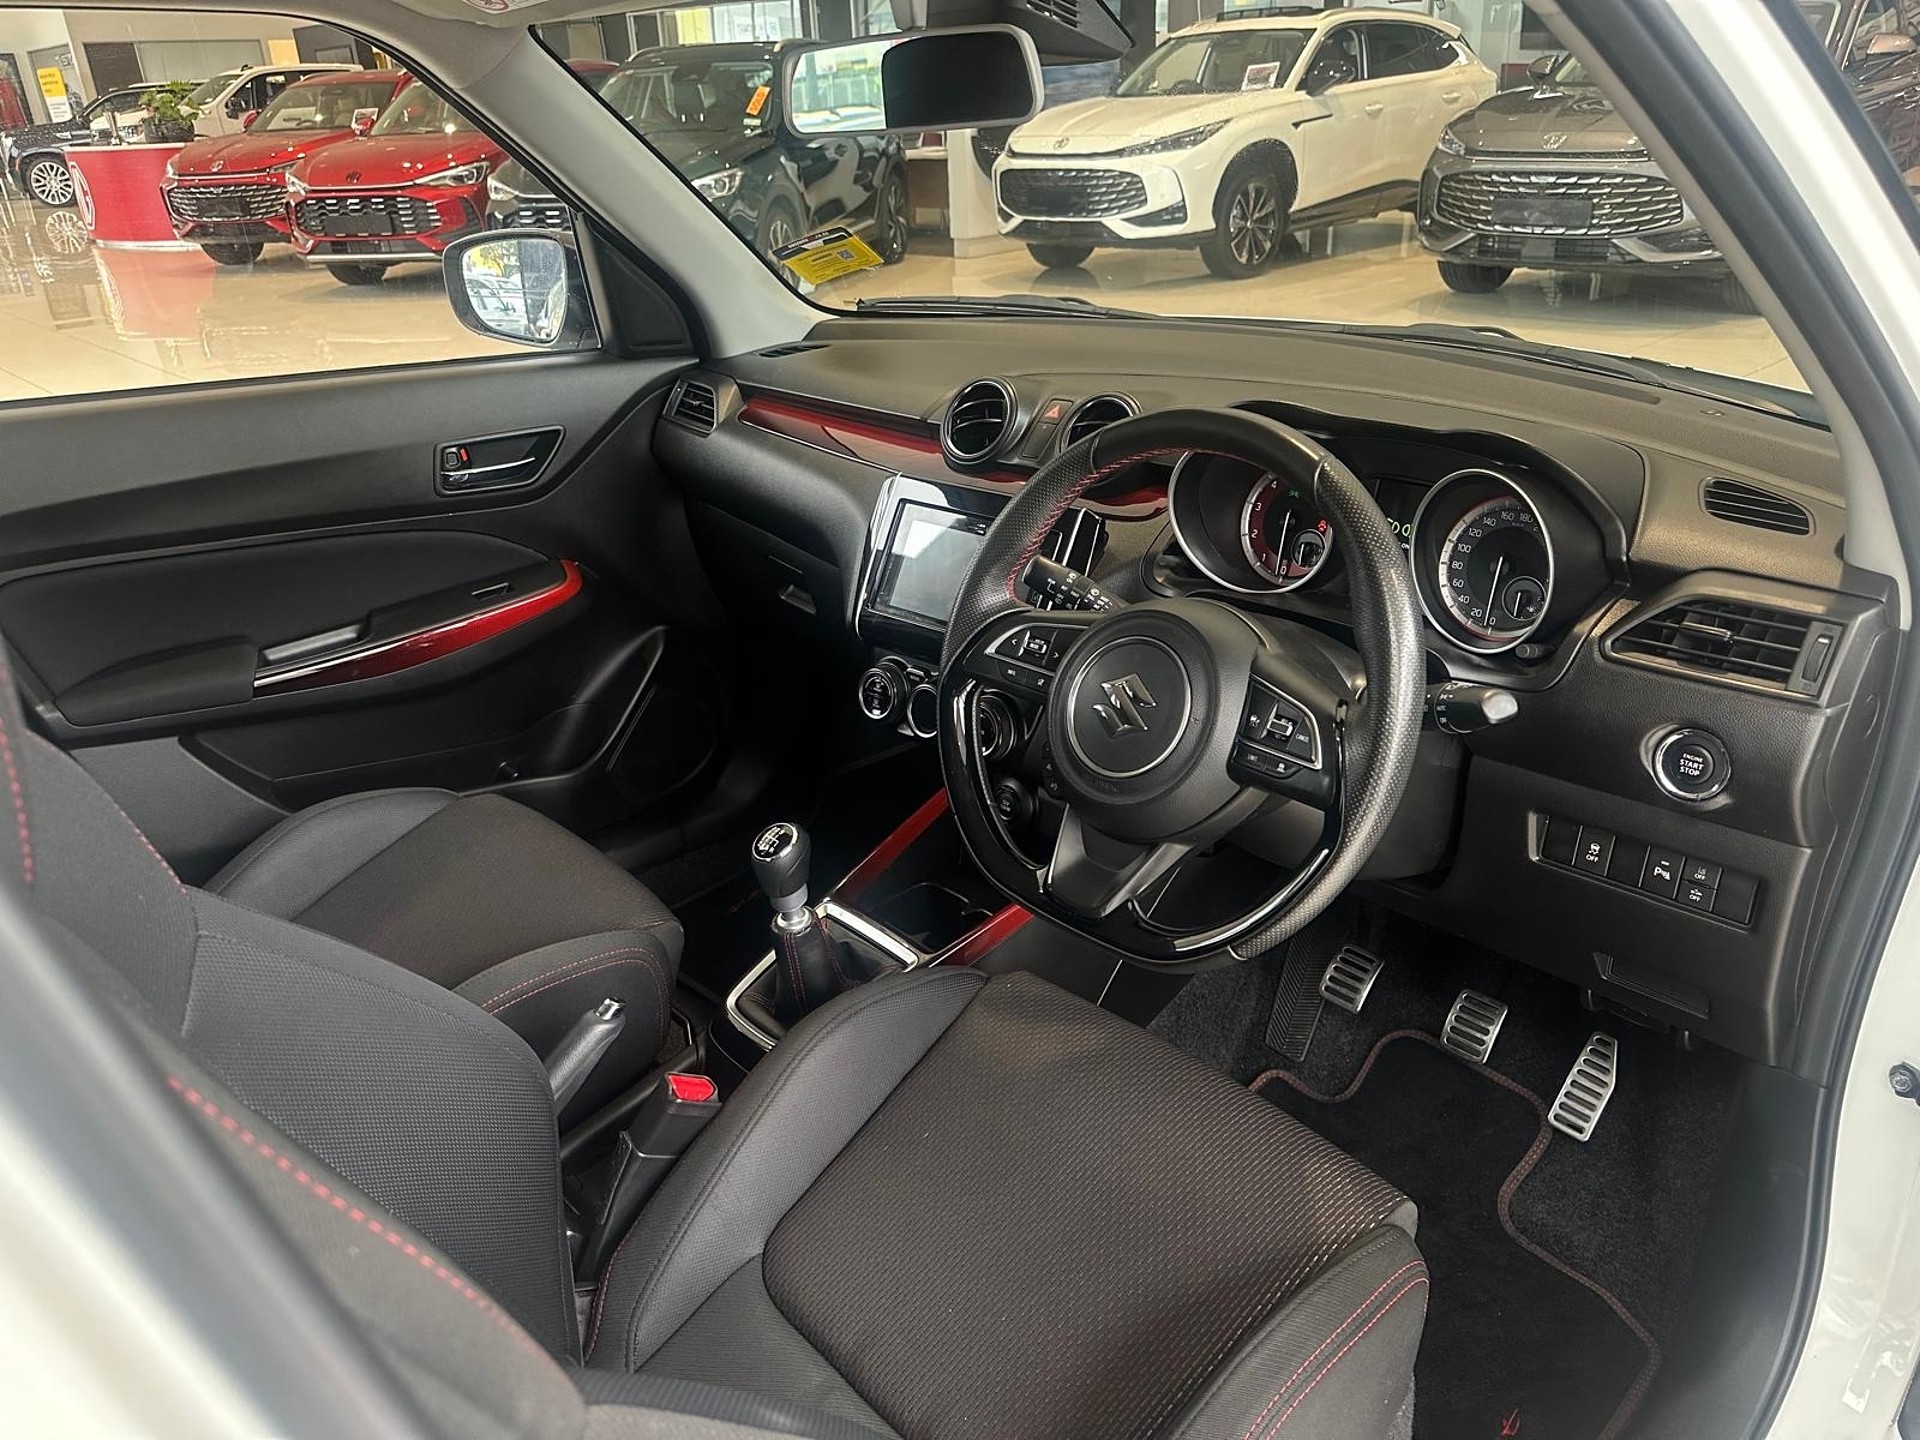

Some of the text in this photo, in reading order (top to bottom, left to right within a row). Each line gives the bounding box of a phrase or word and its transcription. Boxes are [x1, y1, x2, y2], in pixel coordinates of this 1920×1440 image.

[1255, 502, 1262, 511] 3
[1501, 511, 1514, 521] 160
[1483, 517, 1496, 526] 140
[1251, 529, 1258, 538] 2
[1469, 528, 1482, 537] 120
[1457, 543, 1471, 553] 100
[1451, 561, 1463, 570] 80
[1280, 566, 1287, 575] 0
[1453, 579, 1464, 588] 60
[1458, 595, 1470, 604] 40
[1470, 608, 1482, 618] 20
[1489, 617, 1496, 625] 0
[1683, 753, 1703, 763] ENGINE
[1680, 759, 1704, 770] START
[1680, 766, 1700, 776] STOP
[1586, 854, 1599, 863] OFF
[1694, 873, 1706, 881] OFF
[1689, 894, 1701, 902] OFF
